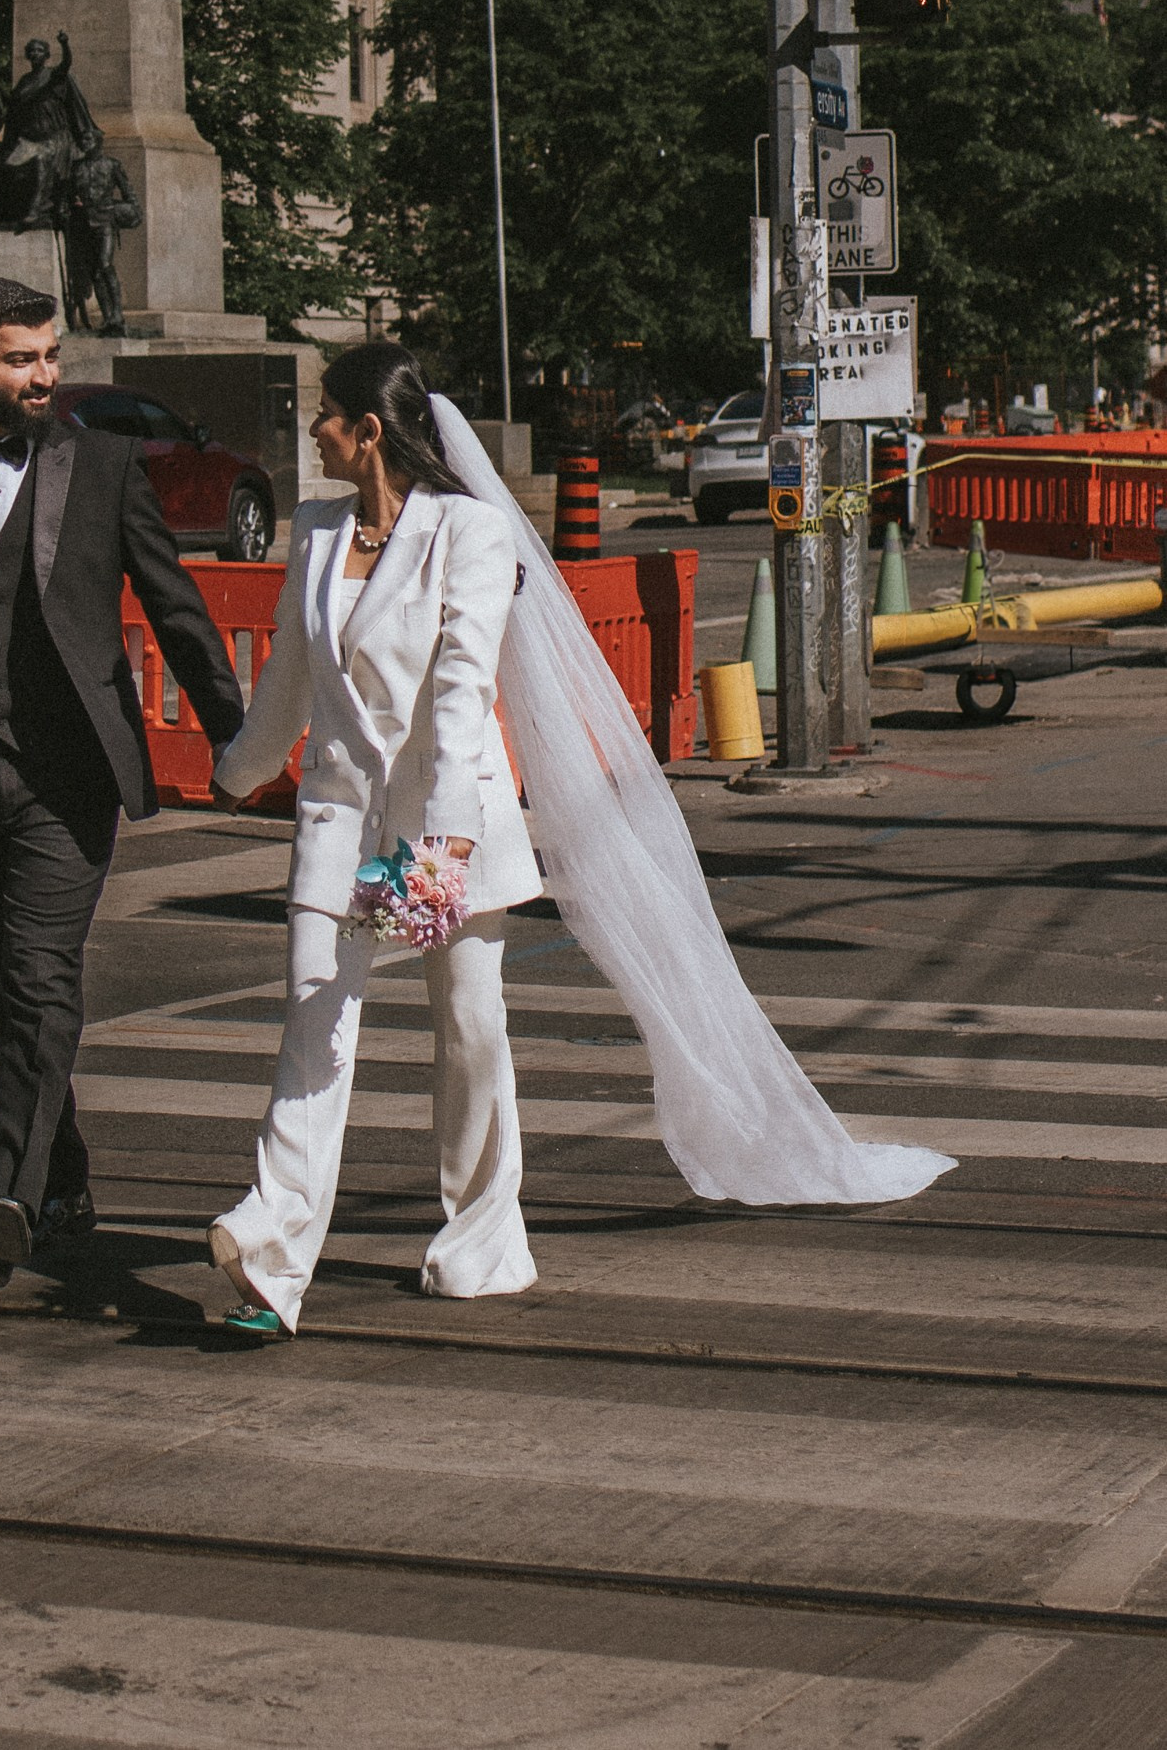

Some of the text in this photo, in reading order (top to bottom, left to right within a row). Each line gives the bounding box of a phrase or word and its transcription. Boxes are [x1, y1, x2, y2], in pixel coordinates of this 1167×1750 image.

[817, 88, 836, 123] ersity
[829, 315, 909, 333] GNATED
[818, 340, 883, 359] OKING
[819, 365, 858, 381] REA
